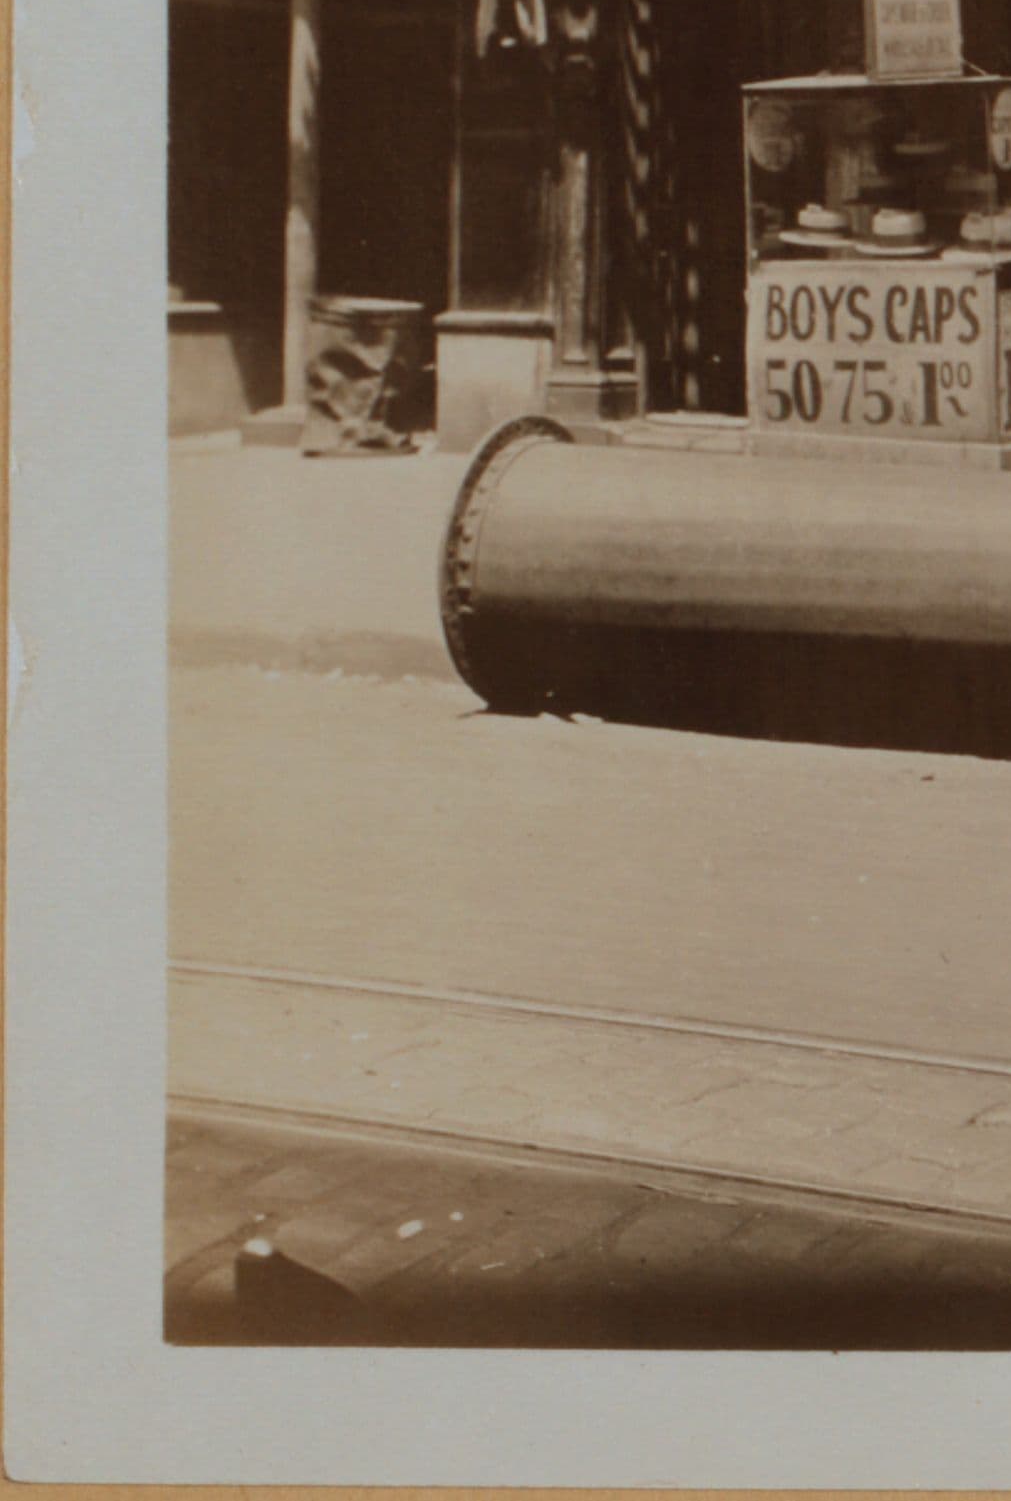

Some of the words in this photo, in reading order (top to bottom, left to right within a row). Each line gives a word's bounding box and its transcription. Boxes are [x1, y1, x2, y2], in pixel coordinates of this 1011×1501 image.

[765, 285, 874, 343] BOYS
[885, 285, 980, 344] CAPS
[765, 359, 823, 423] 50
[834, 359, 894, 425] 75
